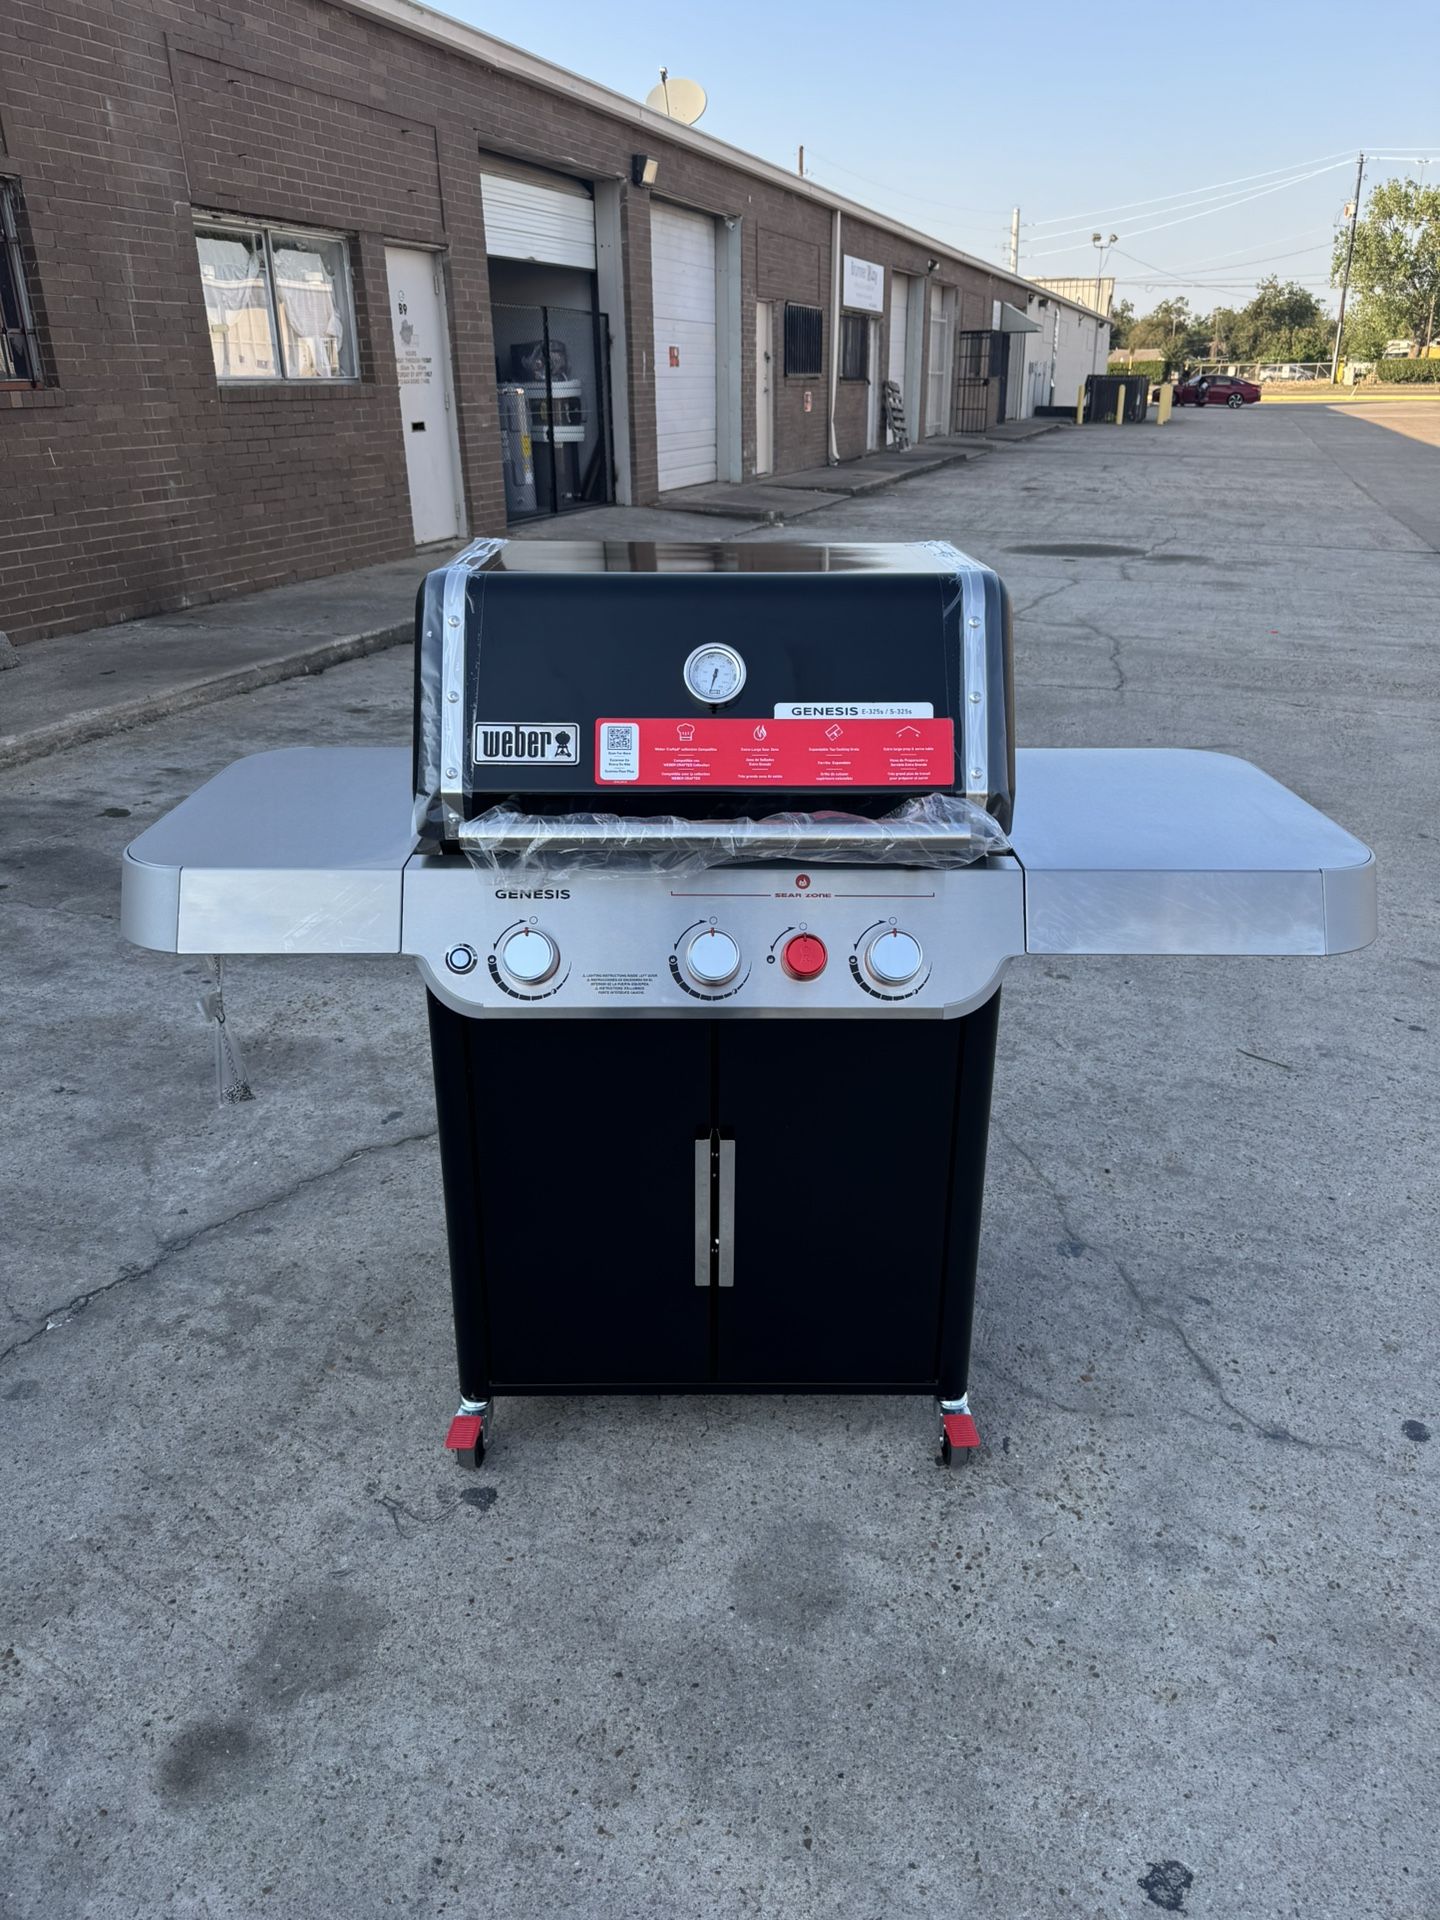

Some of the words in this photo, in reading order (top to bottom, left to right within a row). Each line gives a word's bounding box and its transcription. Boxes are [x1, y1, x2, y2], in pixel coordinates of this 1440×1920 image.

[791, 706, 859, 716] GENESIS
[482, 725, 552, 758] weber
[495, 889, 571, 900] GENESIS
